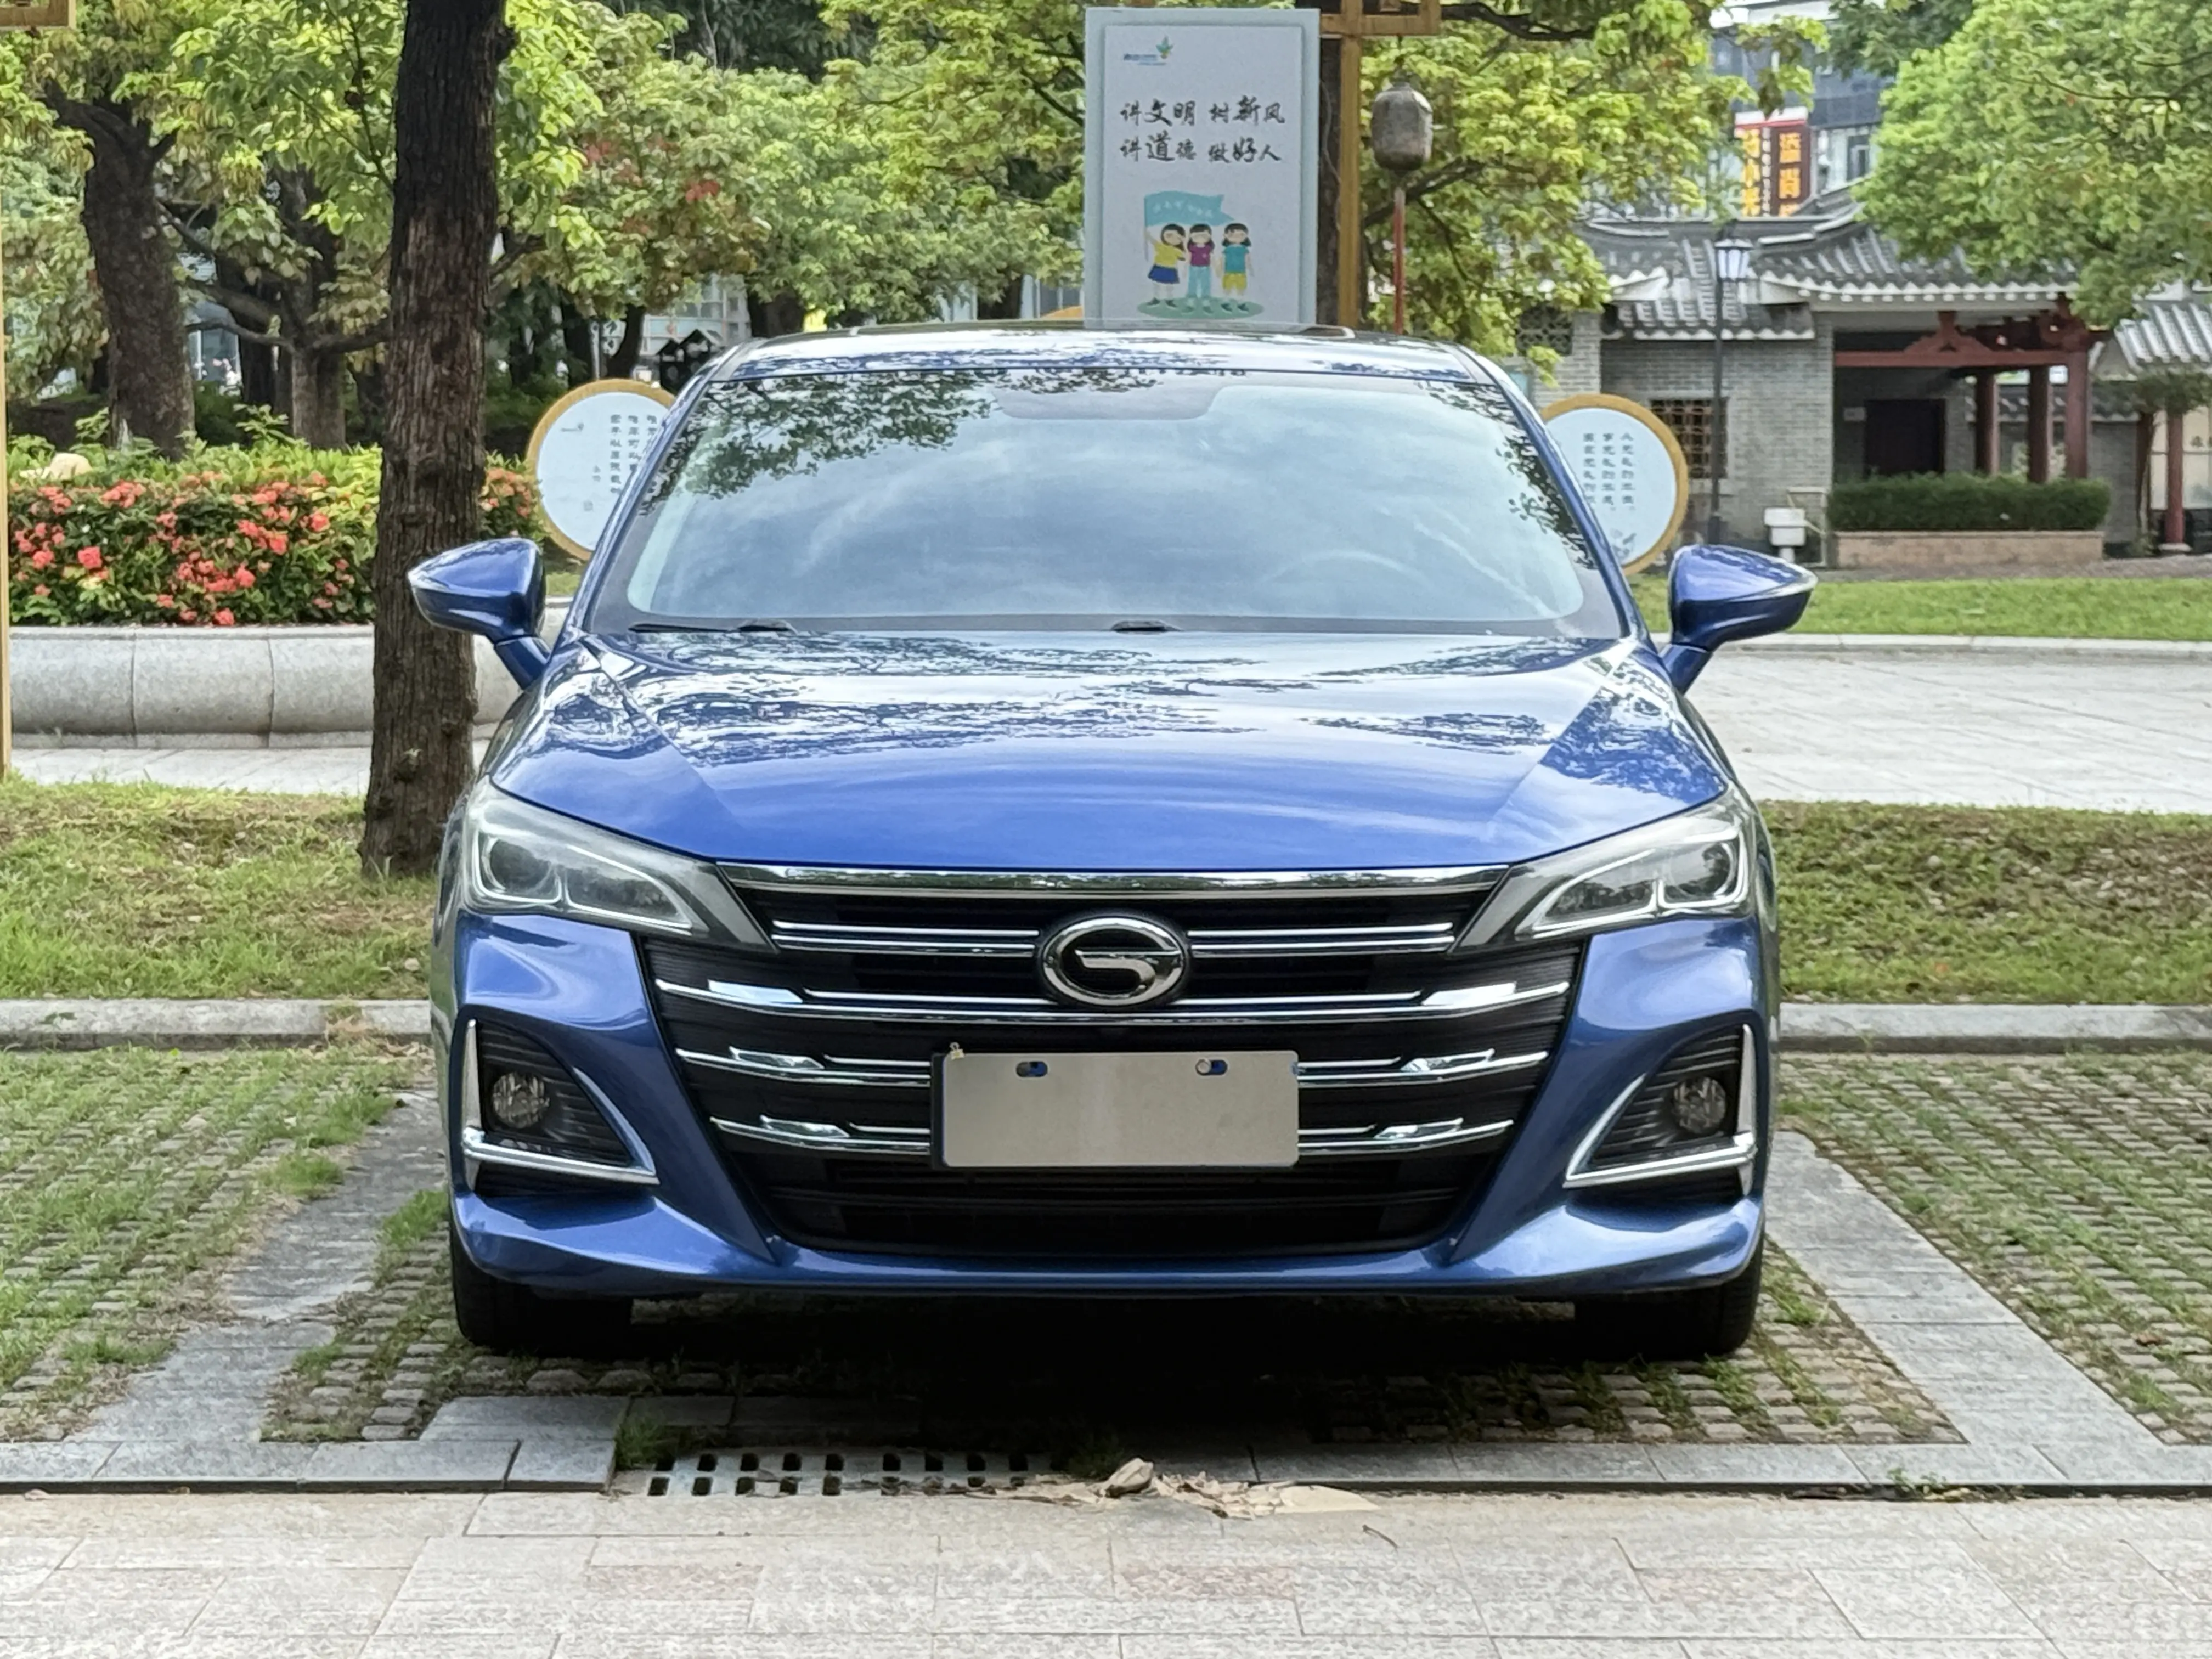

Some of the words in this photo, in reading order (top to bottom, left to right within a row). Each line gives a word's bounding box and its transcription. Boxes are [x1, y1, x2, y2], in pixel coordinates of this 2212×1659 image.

[1120, 98, 1196, 126] 讲文明
[1209, 95, 1285, 126] 树新风
[1120, 129, 1197, 162] 讲道德
[1208, 137, 1283, 164] 做好人
